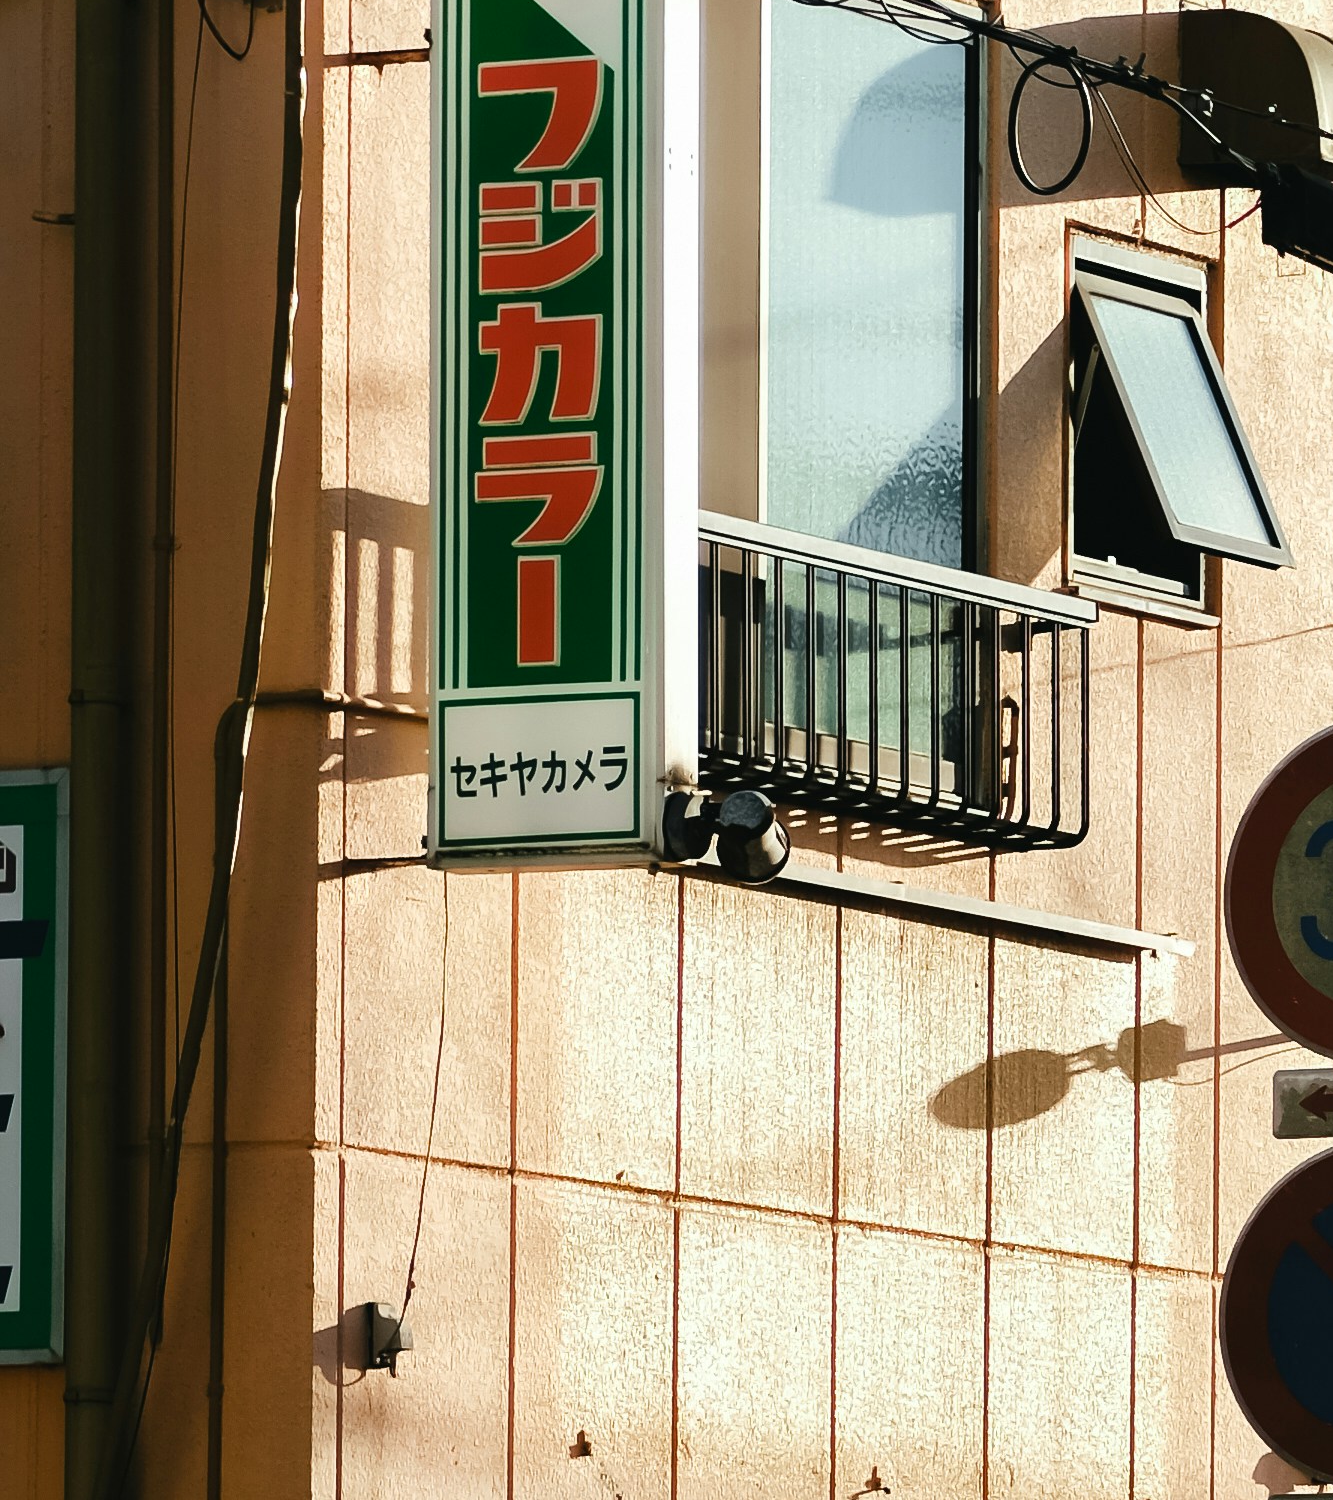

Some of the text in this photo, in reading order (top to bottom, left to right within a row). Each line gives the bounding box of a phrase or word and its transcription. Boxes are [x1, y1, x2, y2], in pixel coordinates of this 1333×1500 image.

[476, 57, 605, 669] フジカラー
[448, 743, 630, 802] セキヤカメラ
